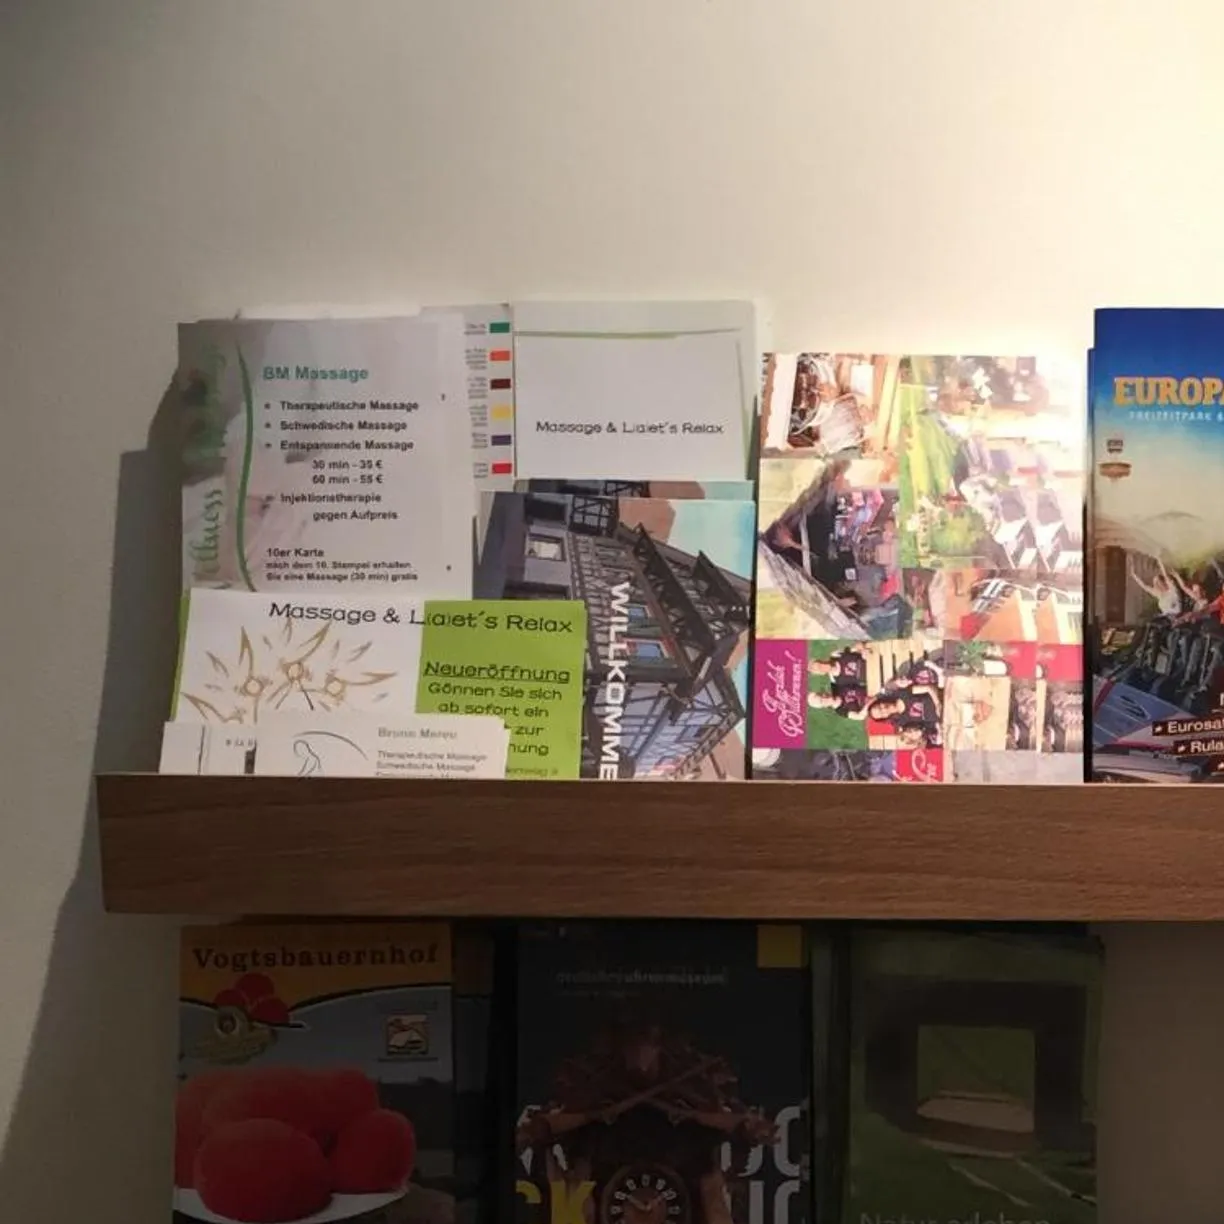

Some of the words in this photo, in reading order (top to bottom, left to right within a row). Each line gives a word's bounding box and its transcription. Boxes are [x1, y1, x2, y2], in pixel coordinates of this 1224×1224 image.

[262, 366, 290, 380] BM
[294, 366, 369, 382] Massage
[280, 400, 366, 412] Therapeutische
[369, 400, 420, 412] Massage
[280, 420, 355, 431] Schwedische
[357, 421, 408, 433] Massage
[535, 420, 603, 435] Massage
[606, 421, 618, 434] &
[680, 421, 725, 434] Relax
[280, 440, 362, 451] Entspannende
[364, 440, 415, 451] Massage
[328, 459, 350, 469] min
[328, 474, 350, 484] min
[280, 492, 382, 505] Injektionstherapie
[312, 512, 348, 522] gegen
[350, 511, 399, 522] Aufpreis
[266, 547, 292, 558] 10er
[294, 548, 325, 558] Karte
[283, 573, 305, 581] eine
[306, 573, 349, 583] Massage
[390, 573, 419, 582] gratis
[268, 602, 377, 626] Massage
[382, 607, 401, 625] &
[506, 614, 574, 633] Relax
[422, 660, 571, 684] Neueröffnung
[427, 681, 496, 697] Gönnen
[498, 685, 525, 699] Sie
[528, 687, 563, 701] sich
[437, 702, 460, 715] ab
[464, 703, 520, 718] sofort
[524, 706, 550, 718] ein
[514, 725, 545, 737] zur
[192, 943, 440, 972] Vogtsbauernhof
